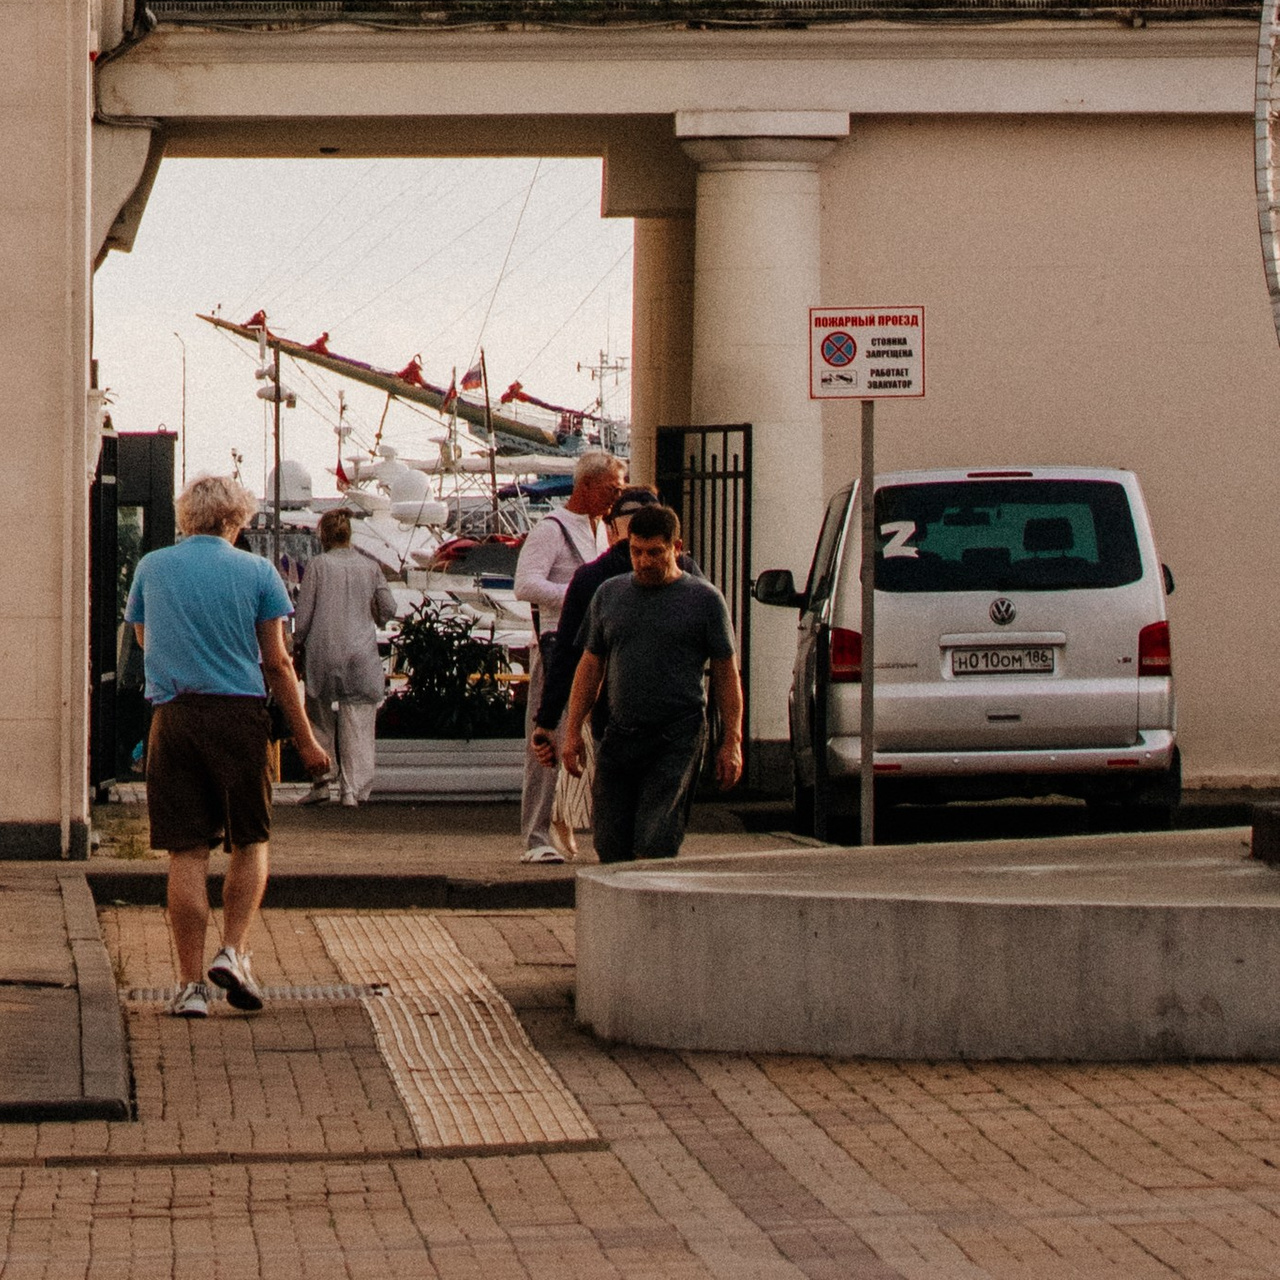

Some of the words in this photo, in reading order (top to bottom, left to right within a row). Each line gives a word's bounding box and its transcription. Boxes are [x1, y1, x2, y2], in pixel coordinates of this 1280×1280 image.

[814, 314, 876, 328] ПОЖАРНЫЙ
[877, 314, 919, 328] ПРОЕЗД
[870, 337, 908, 347] СТОЯНКА
[865, 349, 913, 359] ЗАПРЕЩЕНА
[870, 368, 909, 378] РАБОТАЕТ
[867, 380, 913, 389] ЭВАКУАТОР
[880, 520, 919, 559] Z
